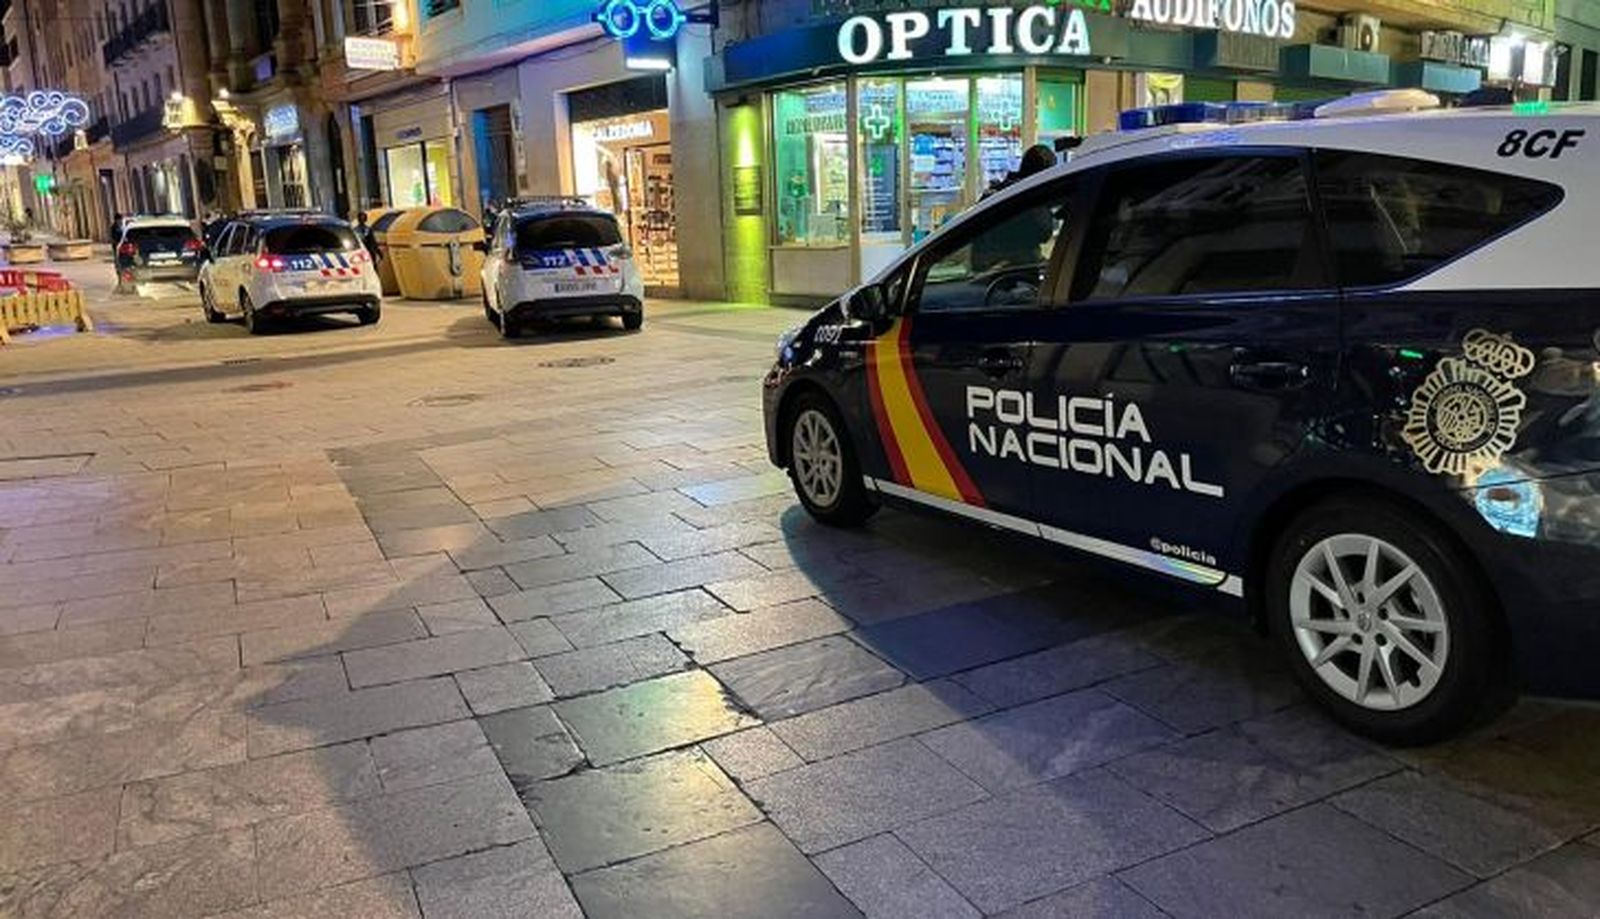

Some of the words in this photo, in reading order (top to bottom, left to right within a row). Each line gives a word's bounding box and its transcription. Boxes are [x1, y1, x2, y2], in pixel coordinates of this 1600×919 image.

[837, 6, 1092, 64] OPTICA
[1497, 129, 1585, 159] 8CF
[291, 259, 313, 269] 112
[543, 255, 566, 266] 112
[966, 385, 1152, 443] POLICÍA
[968, 422, 1225, 498] NACIONAL
